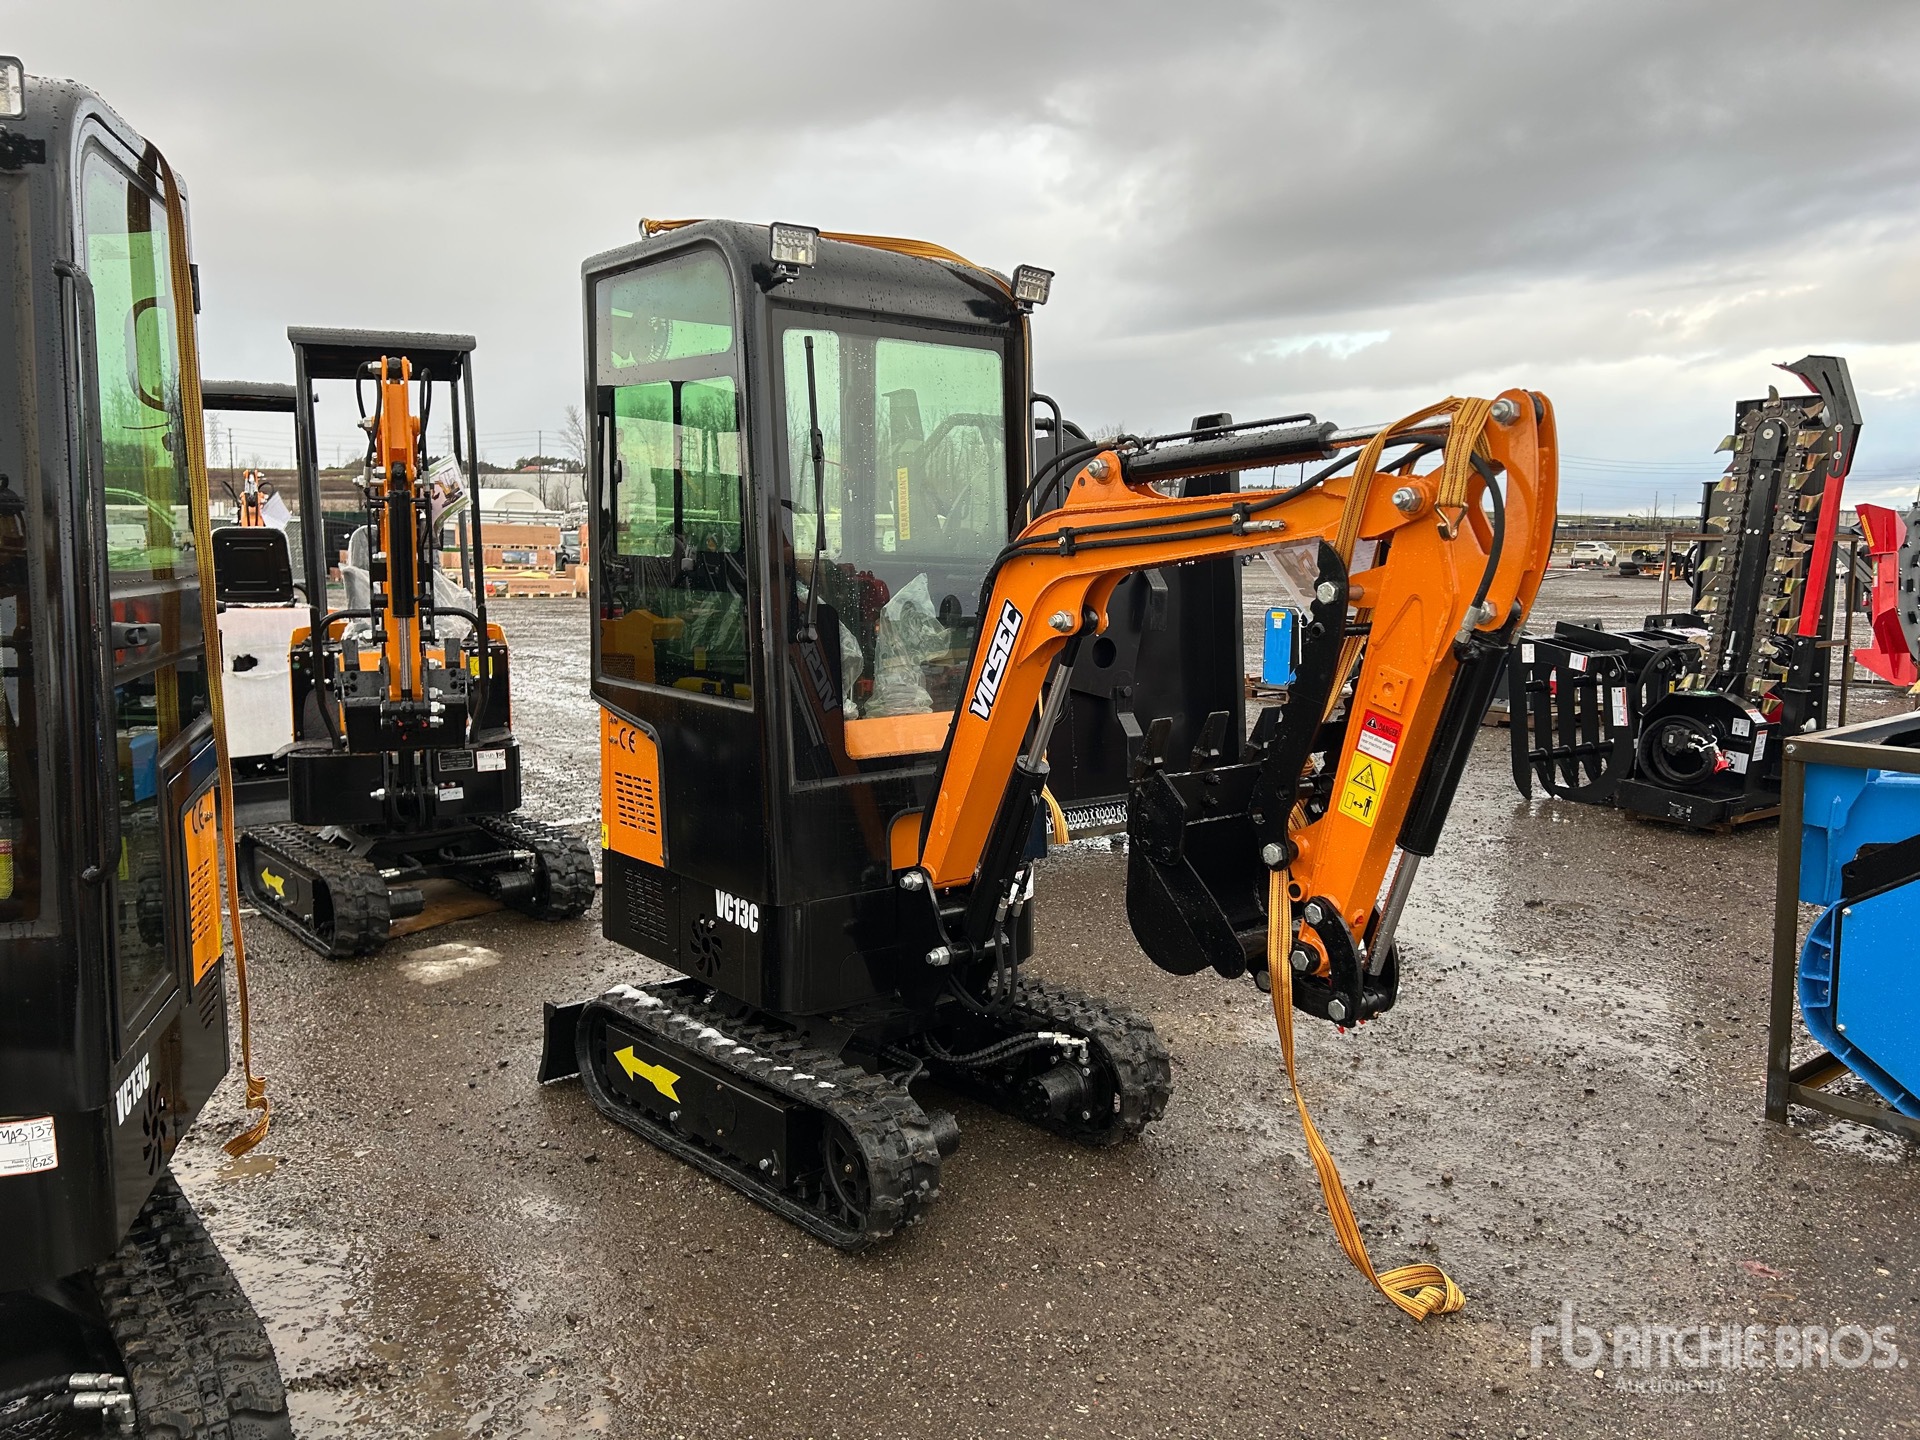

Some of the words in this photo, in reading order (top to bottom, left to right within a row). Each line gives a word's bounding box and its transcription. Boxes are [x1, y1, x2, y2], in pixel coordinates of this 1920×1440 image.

[1378, 723, 1398, 736] DANGER
[715, 888, 759, 933] VC13C
[115, 1052, 150, 1126] VC13C
